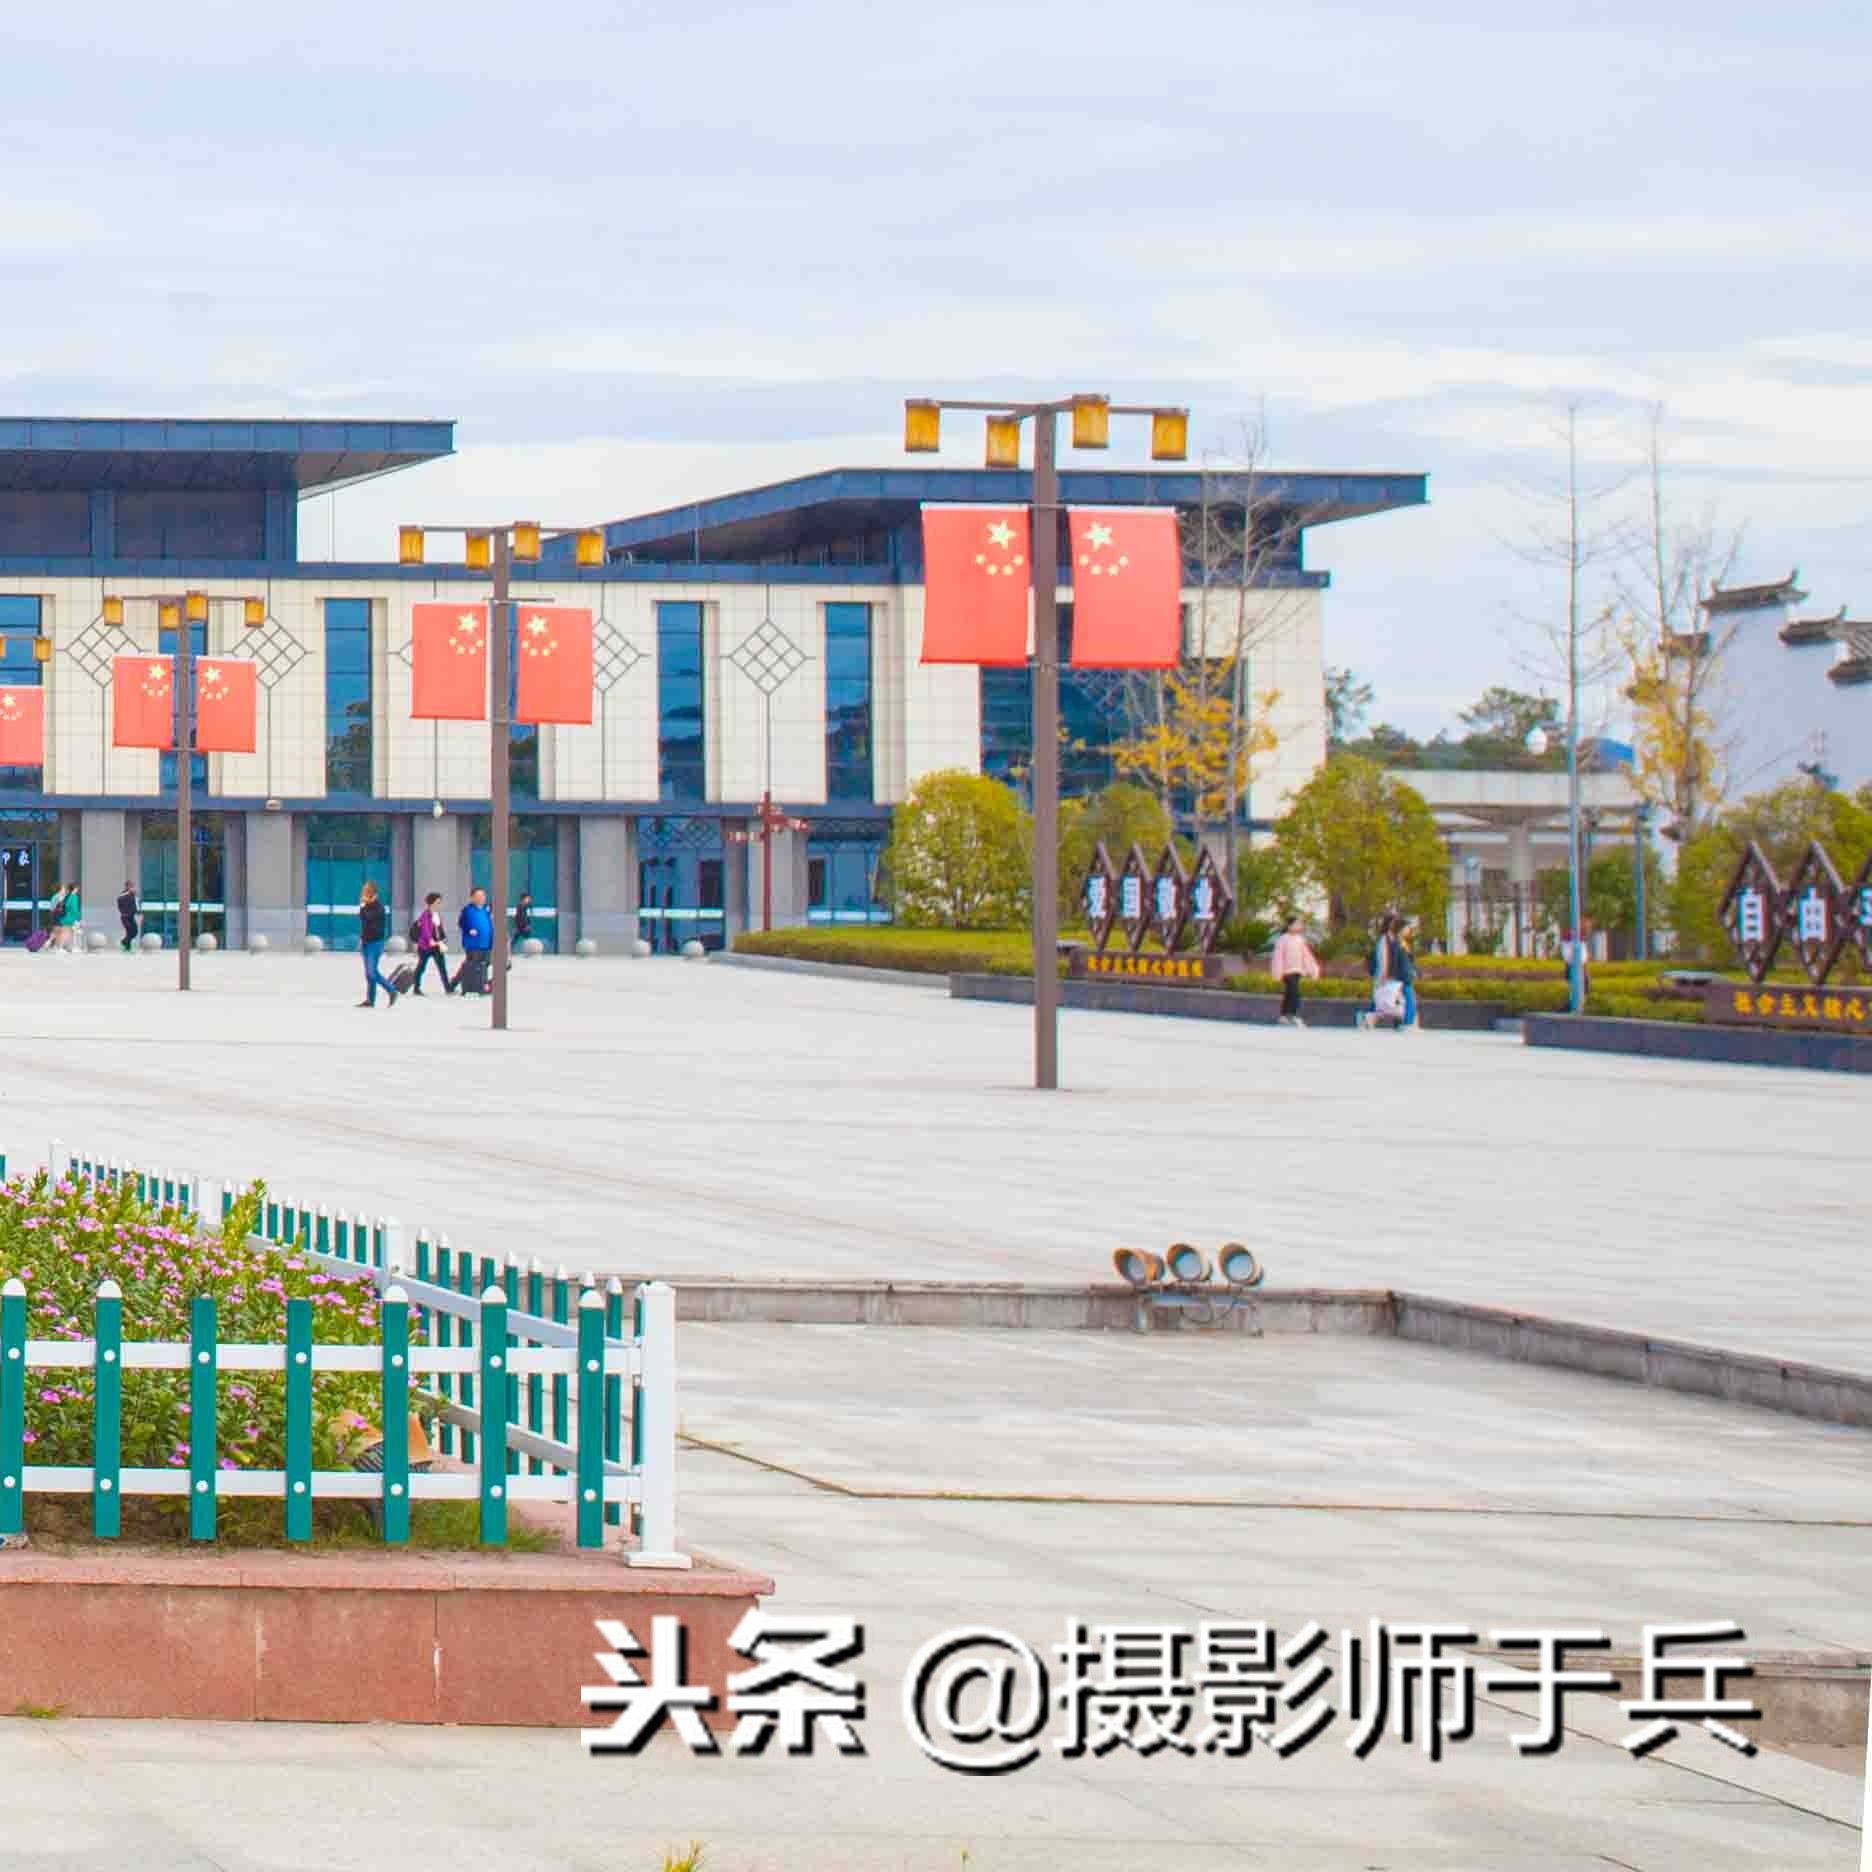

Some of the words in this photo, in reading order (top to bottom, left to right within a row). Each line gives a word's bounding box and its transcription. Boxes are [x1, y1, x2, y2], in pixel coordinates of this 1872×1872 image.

[1734, 991, 1872, 1022] 社会主义核心
